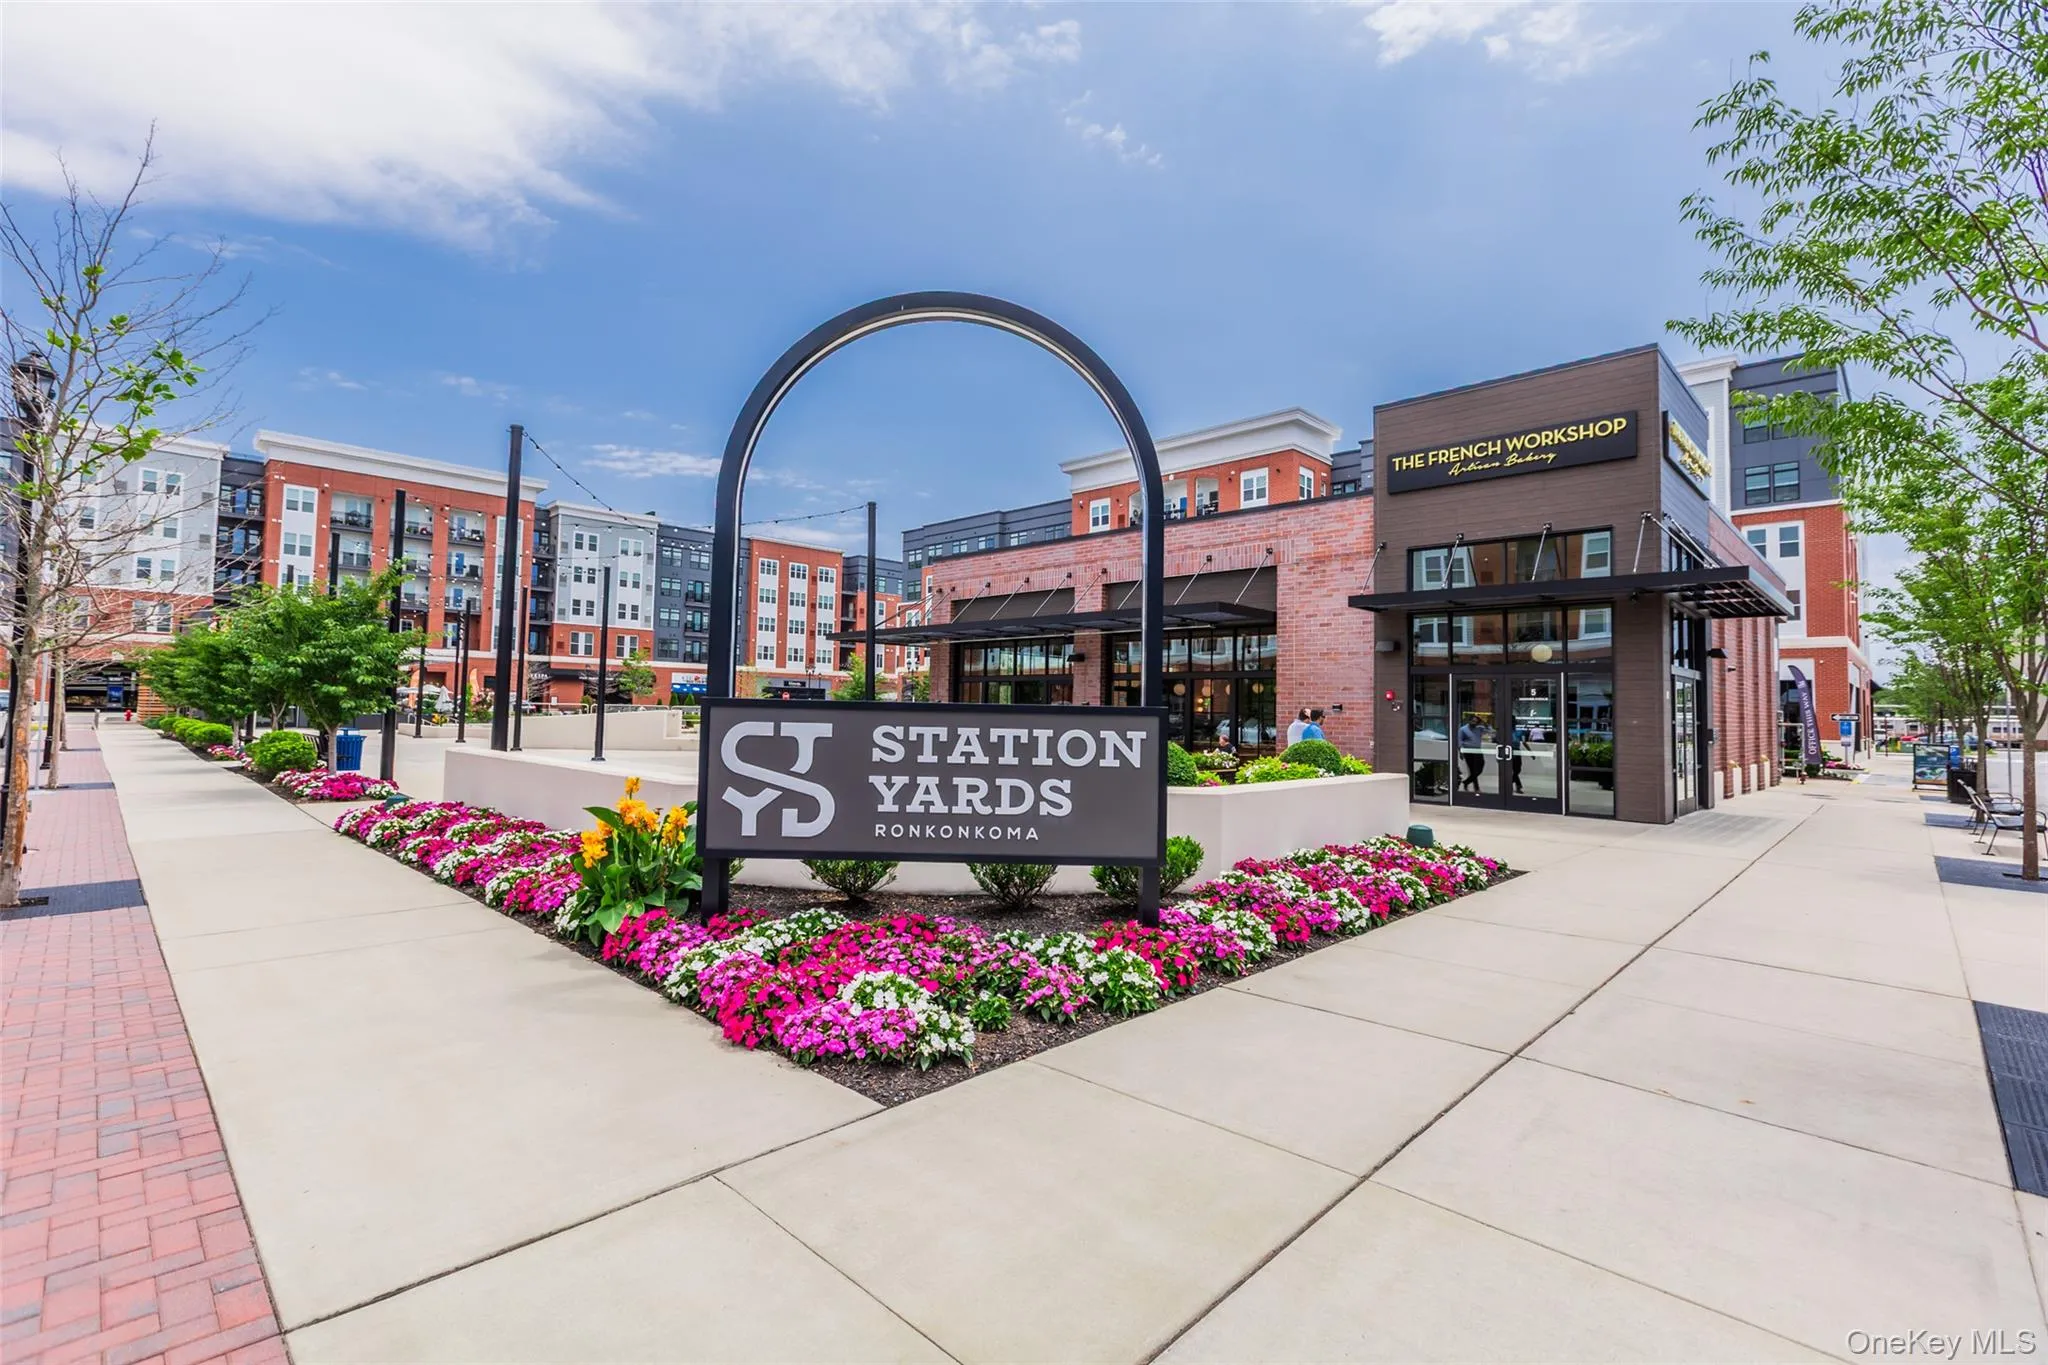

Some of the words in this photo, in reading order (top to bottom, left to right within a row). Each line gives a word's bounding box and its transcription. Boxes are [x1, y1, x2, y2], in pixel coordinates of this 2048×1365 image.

[1392, 453, 1425, 472] THE
[1428, 439, 1501, 466] FRENCH
[1505, 417, 1628, 452] WORKSHOP
[1448, 461, 1500, 476] Artisan
[1503, 451, 1557, 468] Bakery
[1801, 691, 1810, 709] WAY
[1804, 709, 1814, 727] THIS
[871, 725, 1147, 769] STATION
[1807, 728, 1817, 755] OFFICE
[868, 775, 1073, 818] YARDS
[874, 823, 1039, 841] RONKONKOMA
